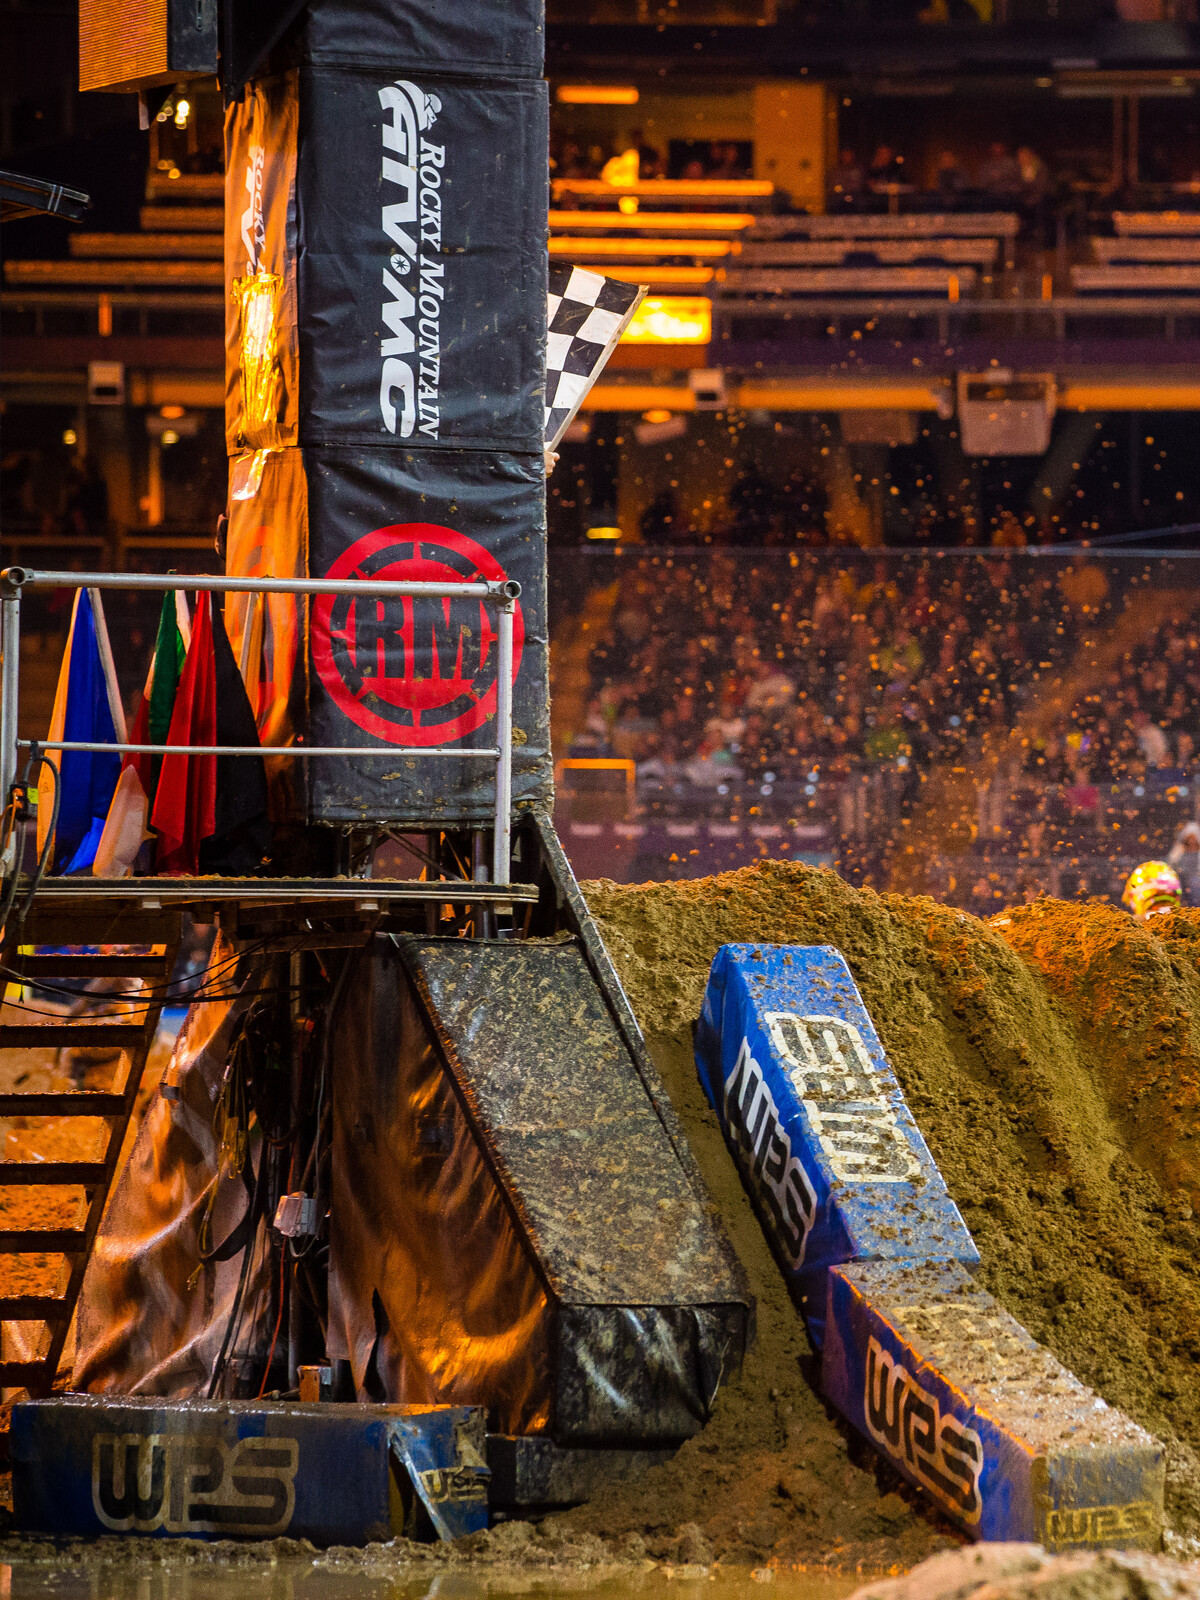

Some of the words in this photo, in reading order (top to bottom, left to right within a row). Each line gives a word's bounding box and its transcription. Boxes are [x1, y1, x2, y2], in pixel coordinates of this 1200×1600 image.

[420, 136, 446, 252] ROCKY
[418, 253, 445, 440] MOUNTAIN
[725, 1036, 819, 1271] WPS
[91, 1433, 300, 1536] WPS
[864, 1334, 984, 1526] WPS
[1047, 1502, 1152, 1543] WPS
